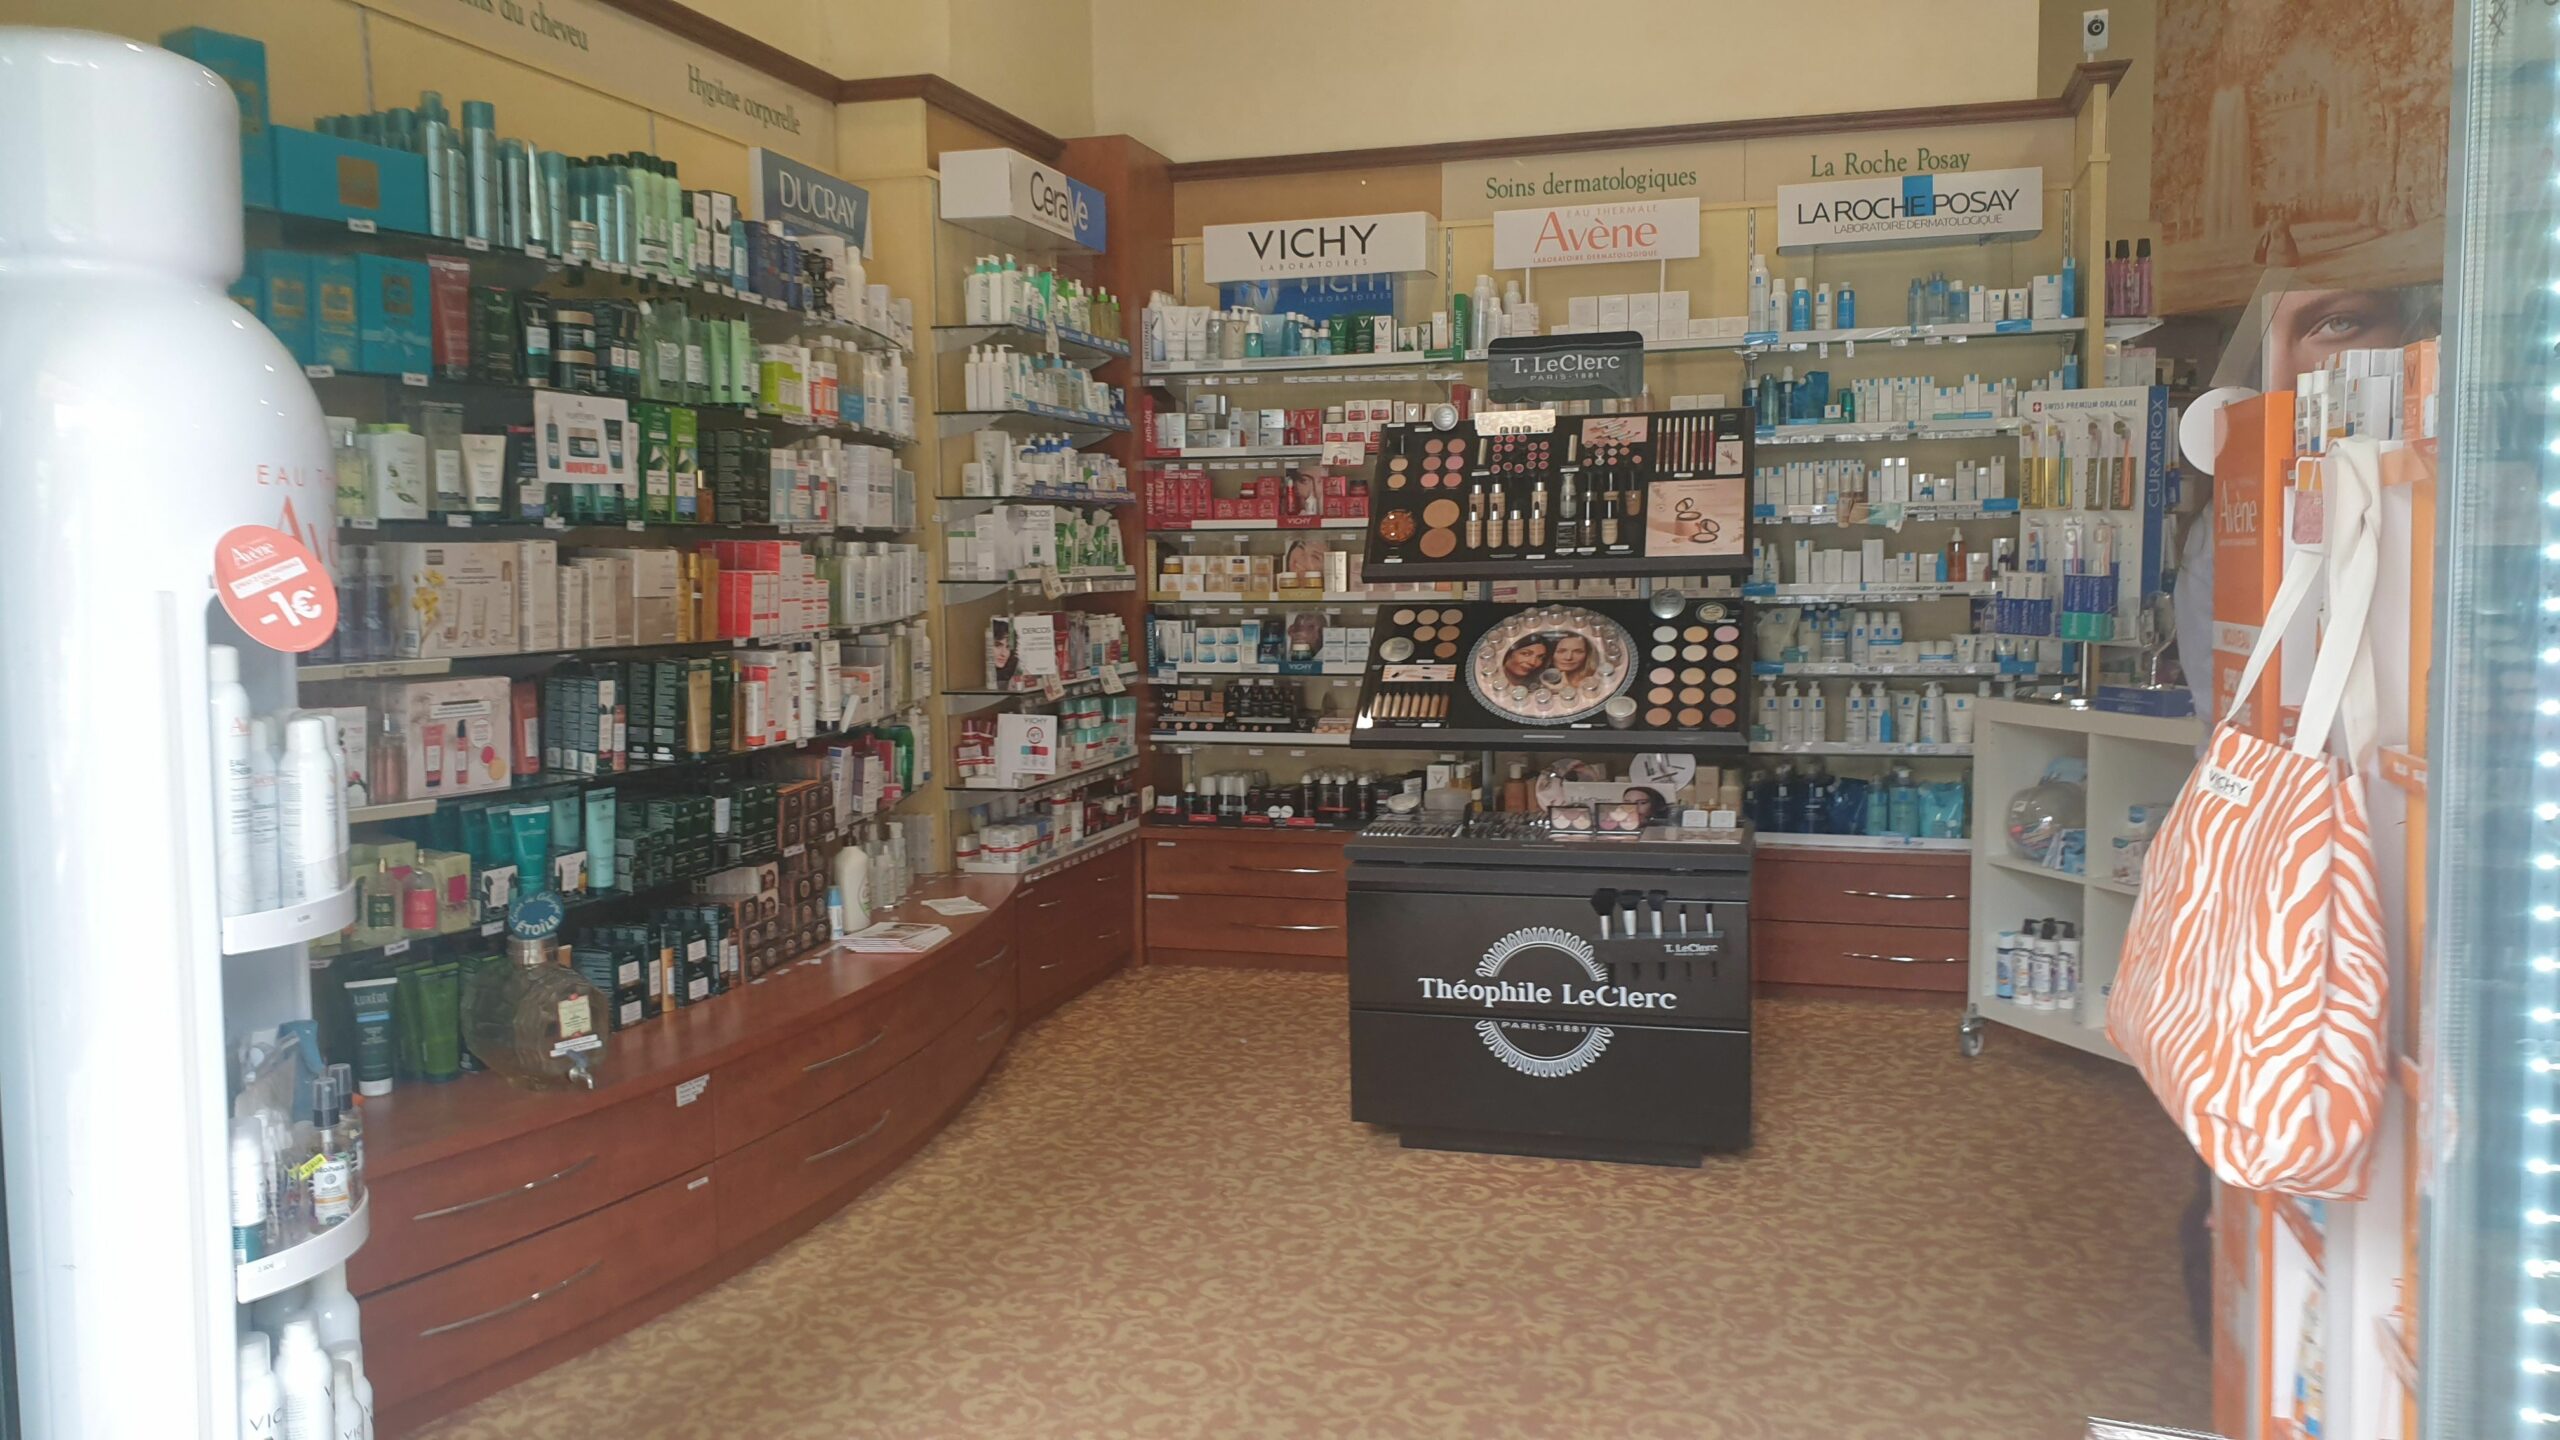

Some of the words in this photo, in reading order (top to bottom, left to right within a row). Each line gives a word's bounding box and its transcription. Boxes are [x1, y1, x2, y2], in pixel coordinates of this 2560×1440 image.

[530, 1, 589, 51] cheveu
[686, 64, 741, 112] Hygiène
[744, 94, 801, 135] corporelle
[1811, 154, 1835, 177] La
[1844, 150, 1907, 175] Roche
[1917, 147, 1970, 173] Posay
[1486, 177, 1536, 200] Soins
[1542, 167, 1697, 196] dermatologiques
[779, 169, 857, 230] DUCRAY
[1030, 171, 1089, 231] CeraVe
[1565, 208, 1592, 219] EAU
[1595, 203, 1658, 218] THERMALE
[1798, 201, 1830, 225] LA
[1834, 195, 1926, 222] ROCHE
[1932, 188, 2020, 216] POSAY
[1534, 210, 1658, 253] Avène
[1834, 219, 1905, 235] LABORATOIRE
[1906, 213, 2004, 230] DERMATOLOGIQUE
[1248, 223, 1378, 260] VICHY
[1260, 257, 1368, 273] LABORATOIRES
[1532, 253, 1584, 264] LABORATOIRE
[1511, 357, 1529, 375] T.
[1533, 353, 1621, 374] LeClerc
[2044, 401, 2065, 410] SWISS
[2066, 400, 2098, 409] PREMIUM
[2100, 399, 2118, 408] ORAL
[2119, 398, 2137, 408] CARE
[2147, 398, 2165, 509] CURAPROX
[256, 464, 305, 487] EAU
[1287, 517, 1312, 525] VICHY
[2219, 479, 2258, 533] Avène
[258, 585, 323, 628] -1€
[1287, 662, 1313, 670] VICHY
[2208, 769, 2249, 797] VICHY
[1675, 943, 1719, 953] LeClerc
[1417, 977, 1553, 1008] Théophile
[1562, 983, 1678, 1010] LeClerc
